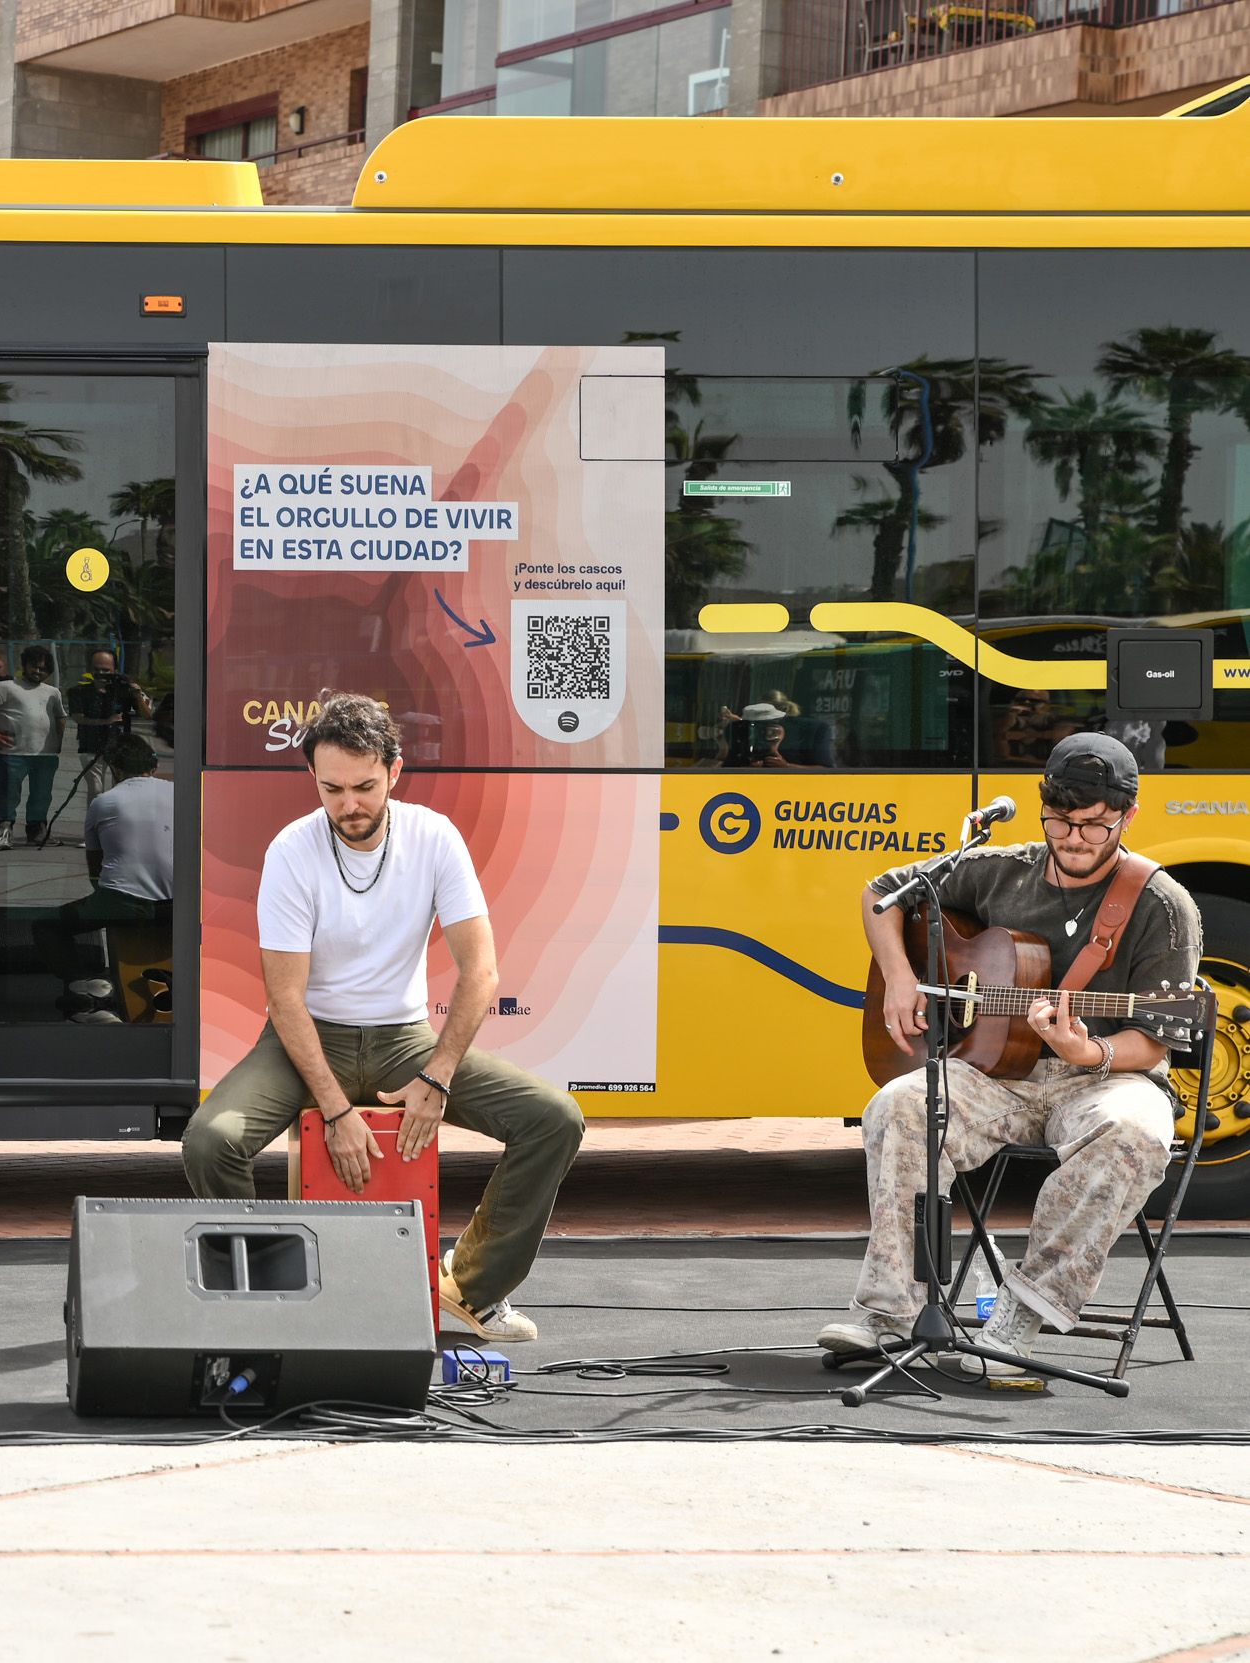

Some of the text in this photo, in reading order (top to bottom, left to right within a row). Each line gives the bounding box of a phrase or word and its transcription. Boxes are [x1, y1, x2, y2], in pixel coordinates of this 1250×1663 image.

[240, 468, 426, 499] ¿A QUÉ SUENA
[240, 507, 512, 529] EL ORGULLO DE VIVIR
[240, 539, 462, 561] EN ESTA CIUDAD?
[515, 563, 622, 576] ¡Ponte los cascos
[514, 579, 626, 592] y descúbrelo aquí!
[1146, 670, 1175, 678] Gas-oil
[774, 800, 898, 824] GUAGUAS
[1165, 800, 1249, 815] SCANIA
[773, 828, 946, 853] MUNICIPALES
[503, 1006, 531, 1015] sgae
